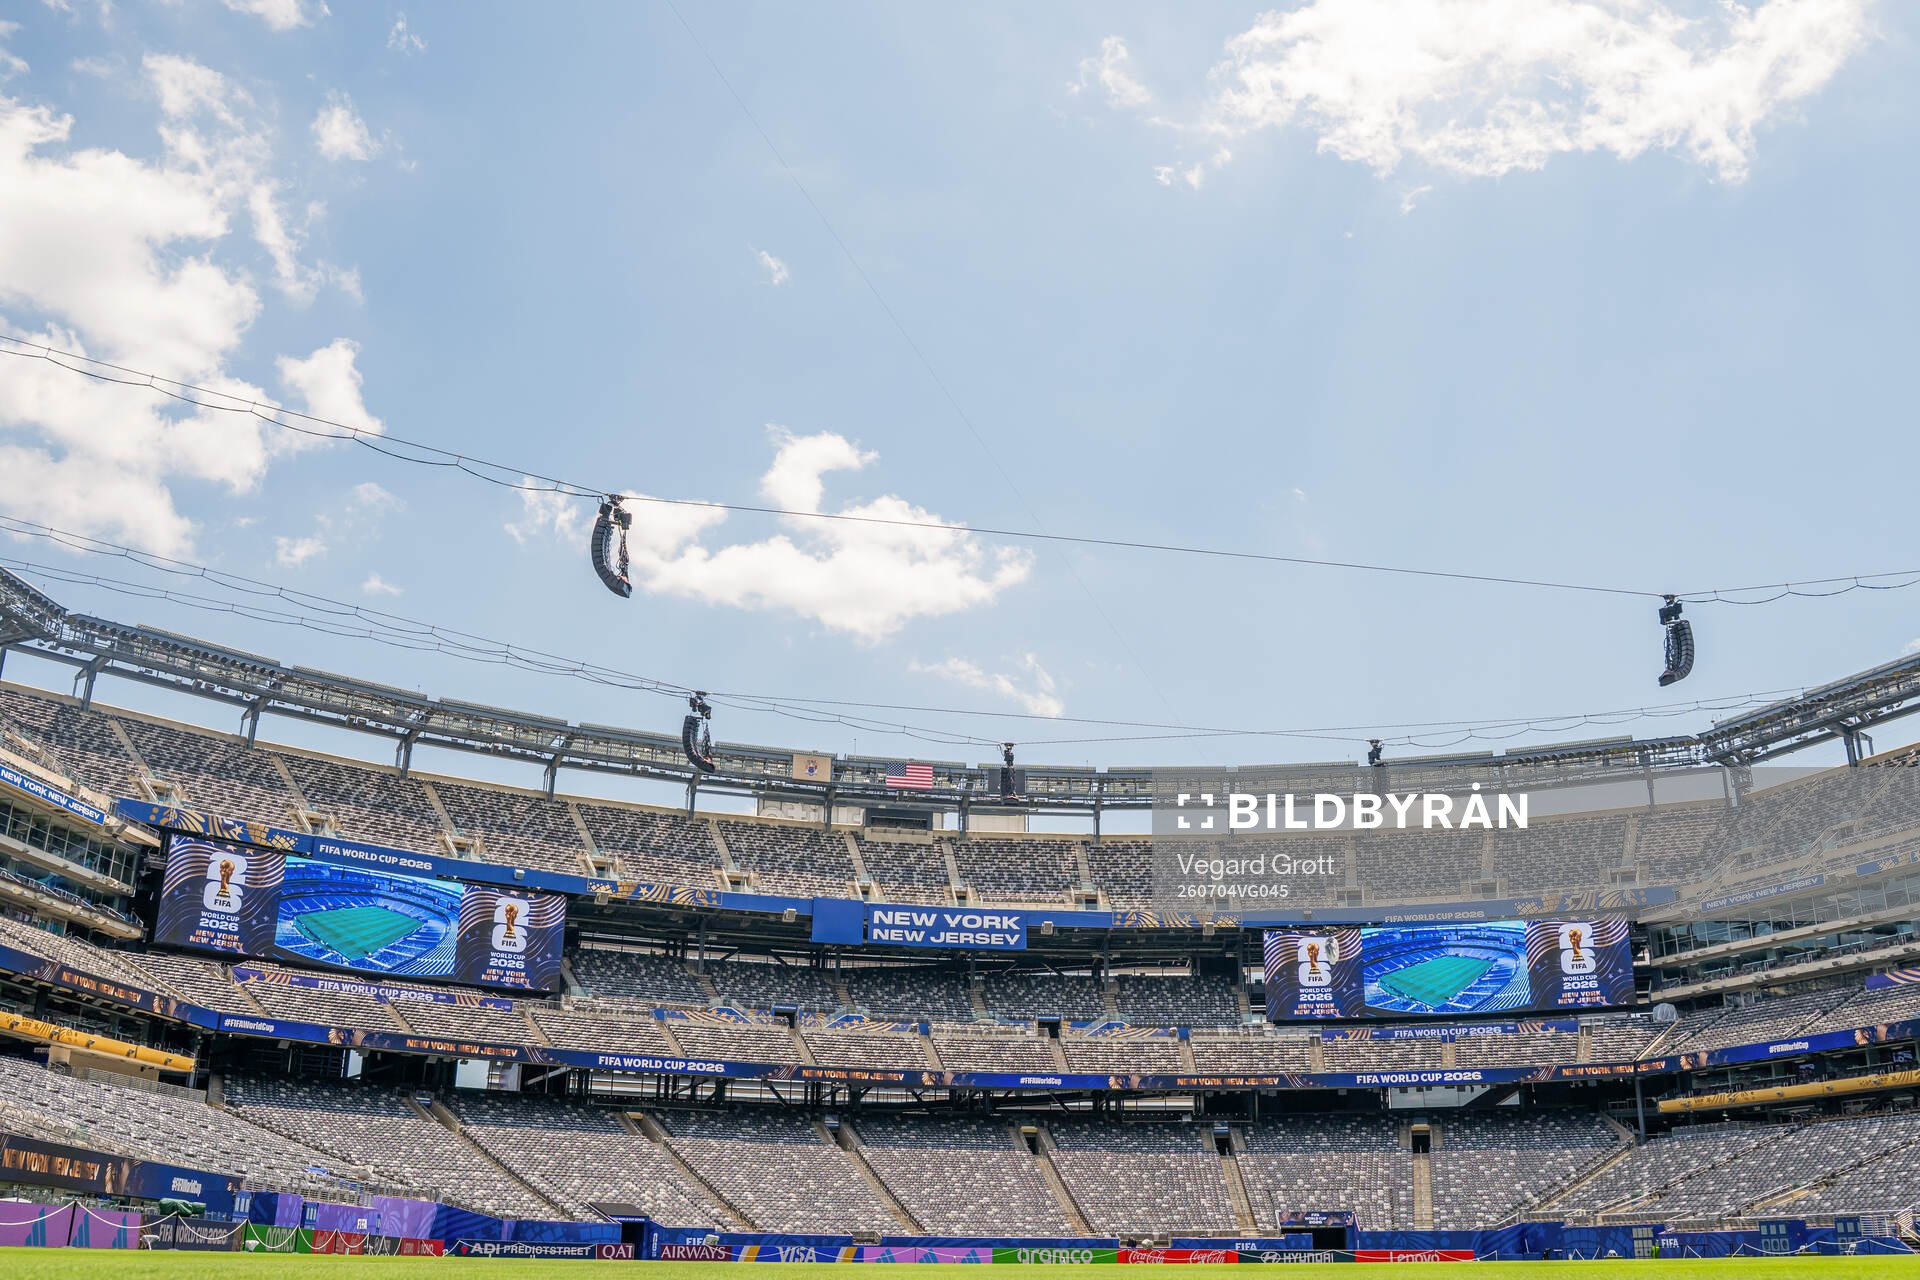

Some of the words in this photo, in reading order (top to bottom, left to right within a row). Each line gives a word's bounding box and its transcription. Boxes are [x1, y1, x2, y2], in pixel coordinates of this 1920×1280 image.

[1, 769, 22, 786] NEW
[23, 780, 47, 796] YORK
[48, 792, 67, 806] NEW
[69, 802, 100, 820] JERSEY
[320, 845, 340, 856] FIFA
[342, 848, 377, 861] WORLD
[379, 855, 398, 865] CUP
[399, 858, 433, 870] 2026
[1706, 898, 1727, 909] NEW
[1729, 892, 1755, 904] YORK
[1755, 887, 1777, 898] NEW
[1780, 877, 1818, 891] JERSEY
[214, 899, 231, 908] FIFA
[201, 911, 226, 920] WORLD
[873, 911, 937, 927] NEW
[943, 914, 1020, 930] YORK
[1385, 915, 1404, 923] FIFA
[1406, 913, 1435, 922] WORLD
[1436, 912, 1453, 920] CUP
[1454, 910, 1485, 919] 2026
[200, 917, 240, 931] 2026
[190, 935, 209, 944] NEW
[211, 938, 244, 949] JERSEY
[195, 930, 215, 938] NEW
[217, 933, 240, 942] YORK
[872, 929, 926, 942] NEW
[930, 932, 1020, 945] JERSEY
[502, 940, 517, 948] FIFA
[490, 958, 525, 969] 2026
[487, 968, 504, 976] NEW
[506, 970, 526, 978] YORK
[62, 971, 79, 985] NEW
[80, 976, 97, 991] YORK
[101, 983, 115, 996] NEW
[115, 988, 142, 1003] JERSEY
[500, 976, 530, 985] JERSEY
[1563, 980, 1599, 990] 2026
[318, 981, 340, 991] FIFA
[342, 983, 377, 995] WORLD
[379, 988, 399, 998] CUP
[400, 990, 434, 1001] 2026
[1299, 993, 1333, 1002] 2026
[1562, 991, 1578, 999] NEW
[224, 1018, 275, 1032] #FIFAWorldCup
[1394, 1030, 1415, 1038] FIFA
[1415, 1029, 1448, 1037] WORLD
[1449, 1028, 1468, 1036] CUP
[1469, 1026, 1501, 1035] 2026
[406, 1039, 430, 1049] NEW
[431, 1042, 456, 1052] YORK
[458, 1045, 479, 1054] NEW
[481, 1047, 518, 1057] JERSEY
[1769, 1042, 1809, 1054] #FIFAWorldCup
[598, 1055, 622, 1067] FIFA
[623, 1057, 662, 1069] WORLD
[664, 1060, 686, 1070] CUP
[687, 1062, 725, 1072] 2026
[1562, 1067, 1584, 1076] NEW
[1585, 1066, 1611, 1075] YORK
[1612, 1065, 1634, 1074] NEW
[1637, 1060, 1666, 1072] JERSEY
[802, 1069, 823, 1078] NEW
[824, 1070, 848, 1079] YORK
[850, 1071, 869, 1080] NEW
[870, 1072, 905, 1081] JERSEY
[1020, 1077, 1062, 1086] #FIFAWorldCup
[1177, 1077, 1197, 1086] NEW
[1198, 1077, 1223, 1086] YORK
[1224, 1077, 1244, 1086] NEW
[1245, 1077, 1279, 1085] JERSEY
[1356, 1075, 1379, 1084] FIFA
[1380, 1074, 1419, 1083] WORLD
[1420, 1073, 1442, 1082] CUP
[1443, 1071, 1482, 1081] 2026
[27, 1152, 48, 1173] YORK
[357, 1218, 368, 1229] FIFA
[159, 1223, 173, 1242] FIFA
[196, 1227, 207, 1244] CUP
[207, 1227, 228, 1246] 2026
[471, 1243, 500, 1256] ADI
[504, 1245, 591, 1256] PREDICTSTREET
[1236, 1242, 1258, 1251] FIFA
[1661, 1238, 1680, 1249] FIFA
[661, 1246, 727, 1260] AIRWAYS
[777, 1246, 817, 1262] VISA
[1017, 1249, 1093, 1264] aramco
[1284, 1252, 1333, 1264] HYUNDAI
[1390, 1251, 1440, 1263] Lenovo
